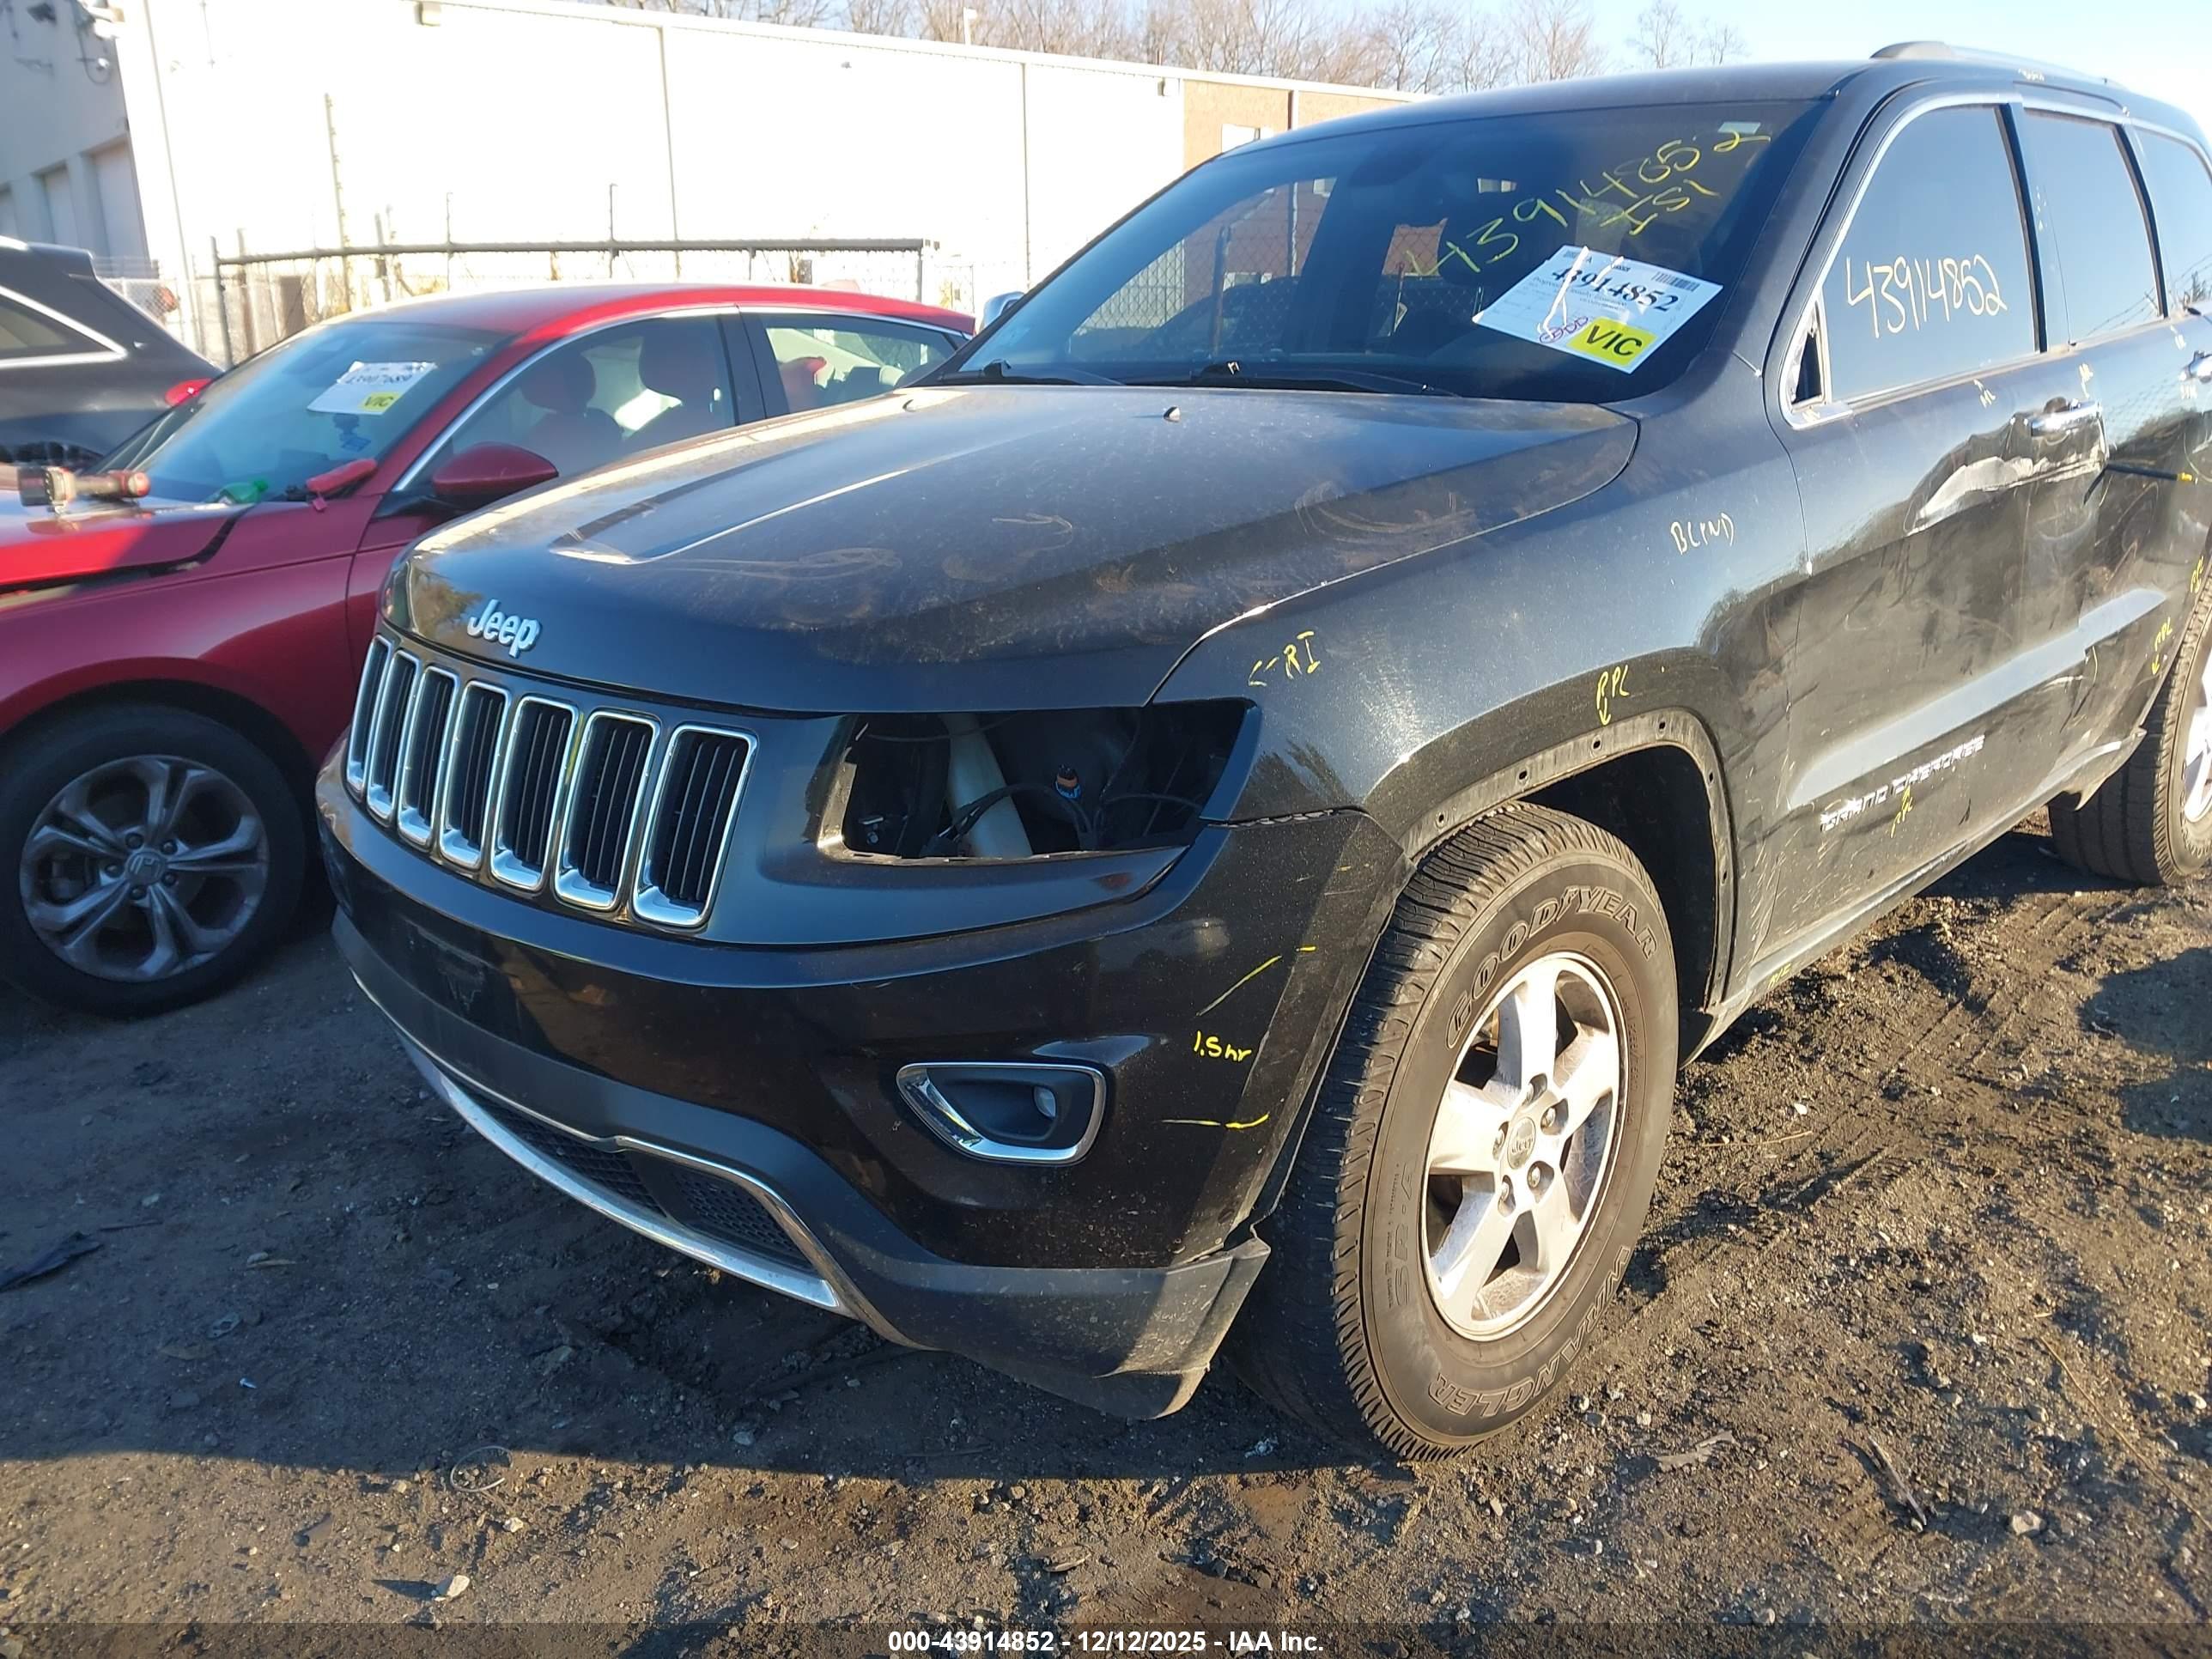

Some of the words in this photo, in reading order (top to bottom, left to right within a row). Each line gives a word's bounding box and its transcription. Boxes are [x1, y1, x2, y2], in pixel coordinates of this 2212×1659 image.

[1585, 323, 1643, 356] VIC
[1846, 254, 2007, 337] 43914852
[466, 599, 543, 659] Jeep
[1820, 784, 1889, 833] GRAND
[1891, 733, 1986, 798] CHEROKEE
[1445, 885, 1658, 1050] GOODYEAR
[1427, 1245, 1631, 1419] WRANGLER
